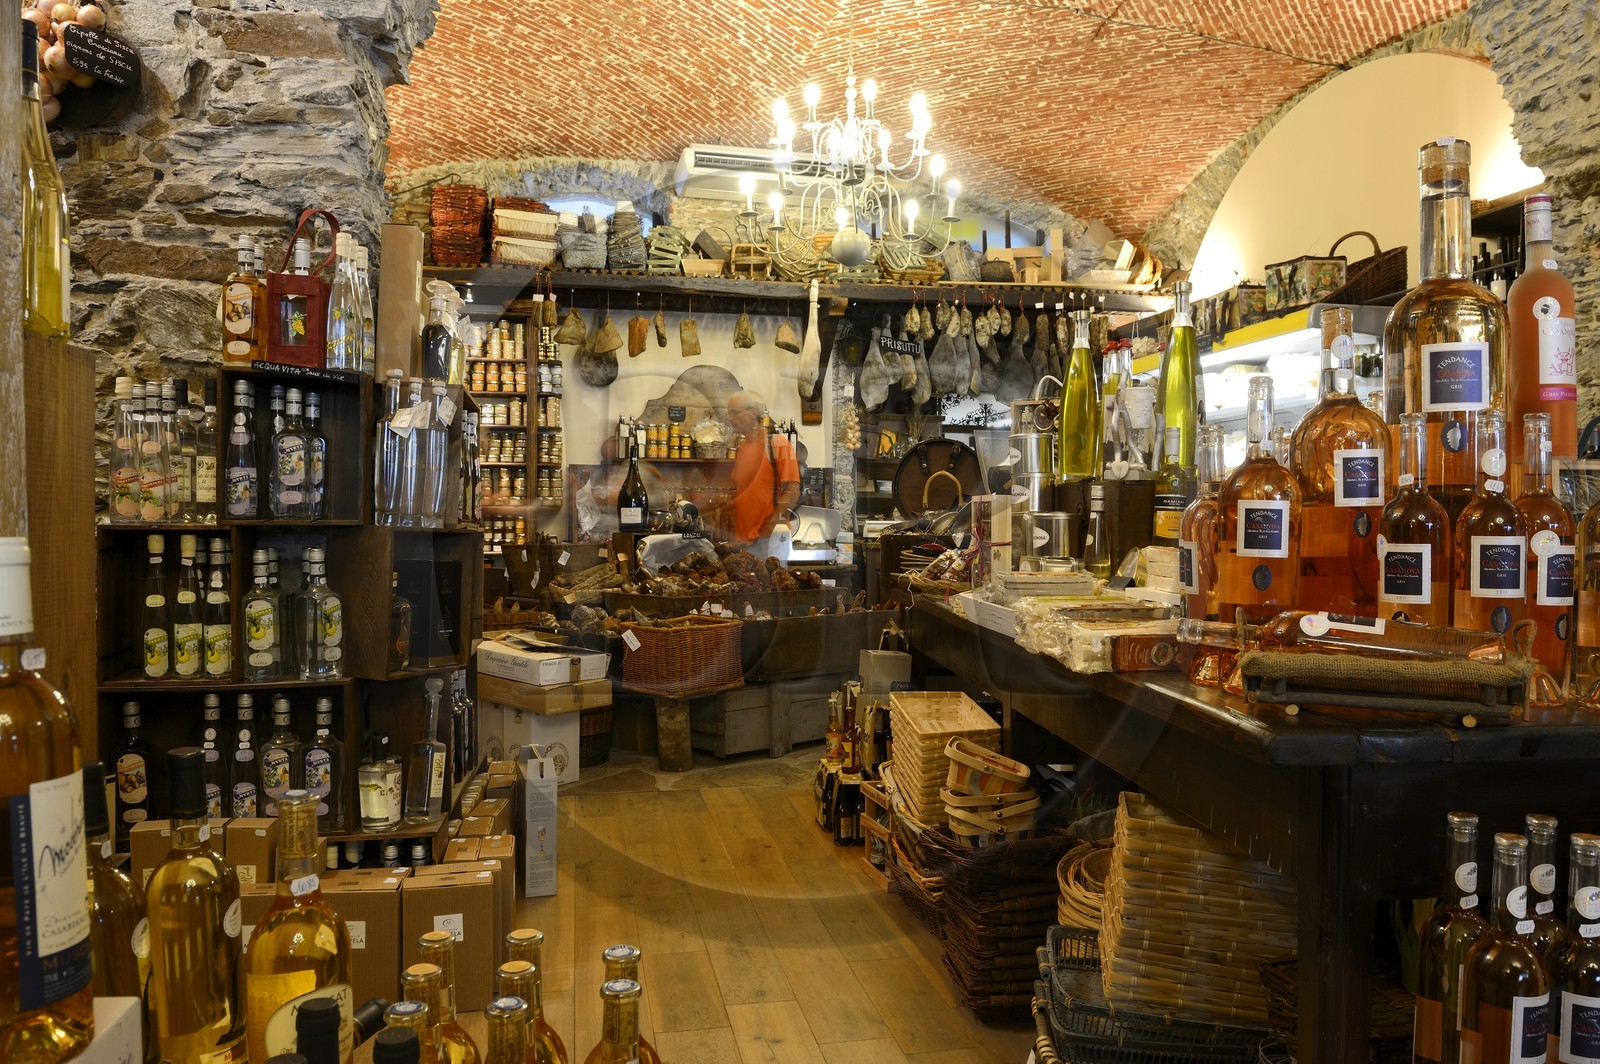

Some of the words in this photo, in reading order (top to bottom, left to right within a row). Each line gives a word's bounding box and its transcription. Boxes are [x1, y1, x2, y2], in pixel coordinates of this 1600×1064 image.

[96, 52, 105, 61] de
[880, 336, 921, 354] PRISUTTU
[253, 361, 280, 372] ACQUA
[281, 365, 301, 375] VITA
[1437, 356, 1475, 370] TENDANCE
[285, 444, 303, 453] MYRTE
[1347, 458, 1375, 468] TENDANCE
[1249, 510, 1279, 520] TENDANCE
[1485, 546, 1517, 557] TENDANCE
[1388, 554, 1417, 564] TENDANCE
[271, 757, 289, 766] MYRTE
[313, 757, 330, 766] MYRTE
[206, 791, 220, 800] YRTE
[239, 789, 256, 800] MYRTE
[294, 878, 316, 893] 10,85
[25, 925, 31, 936] DE
